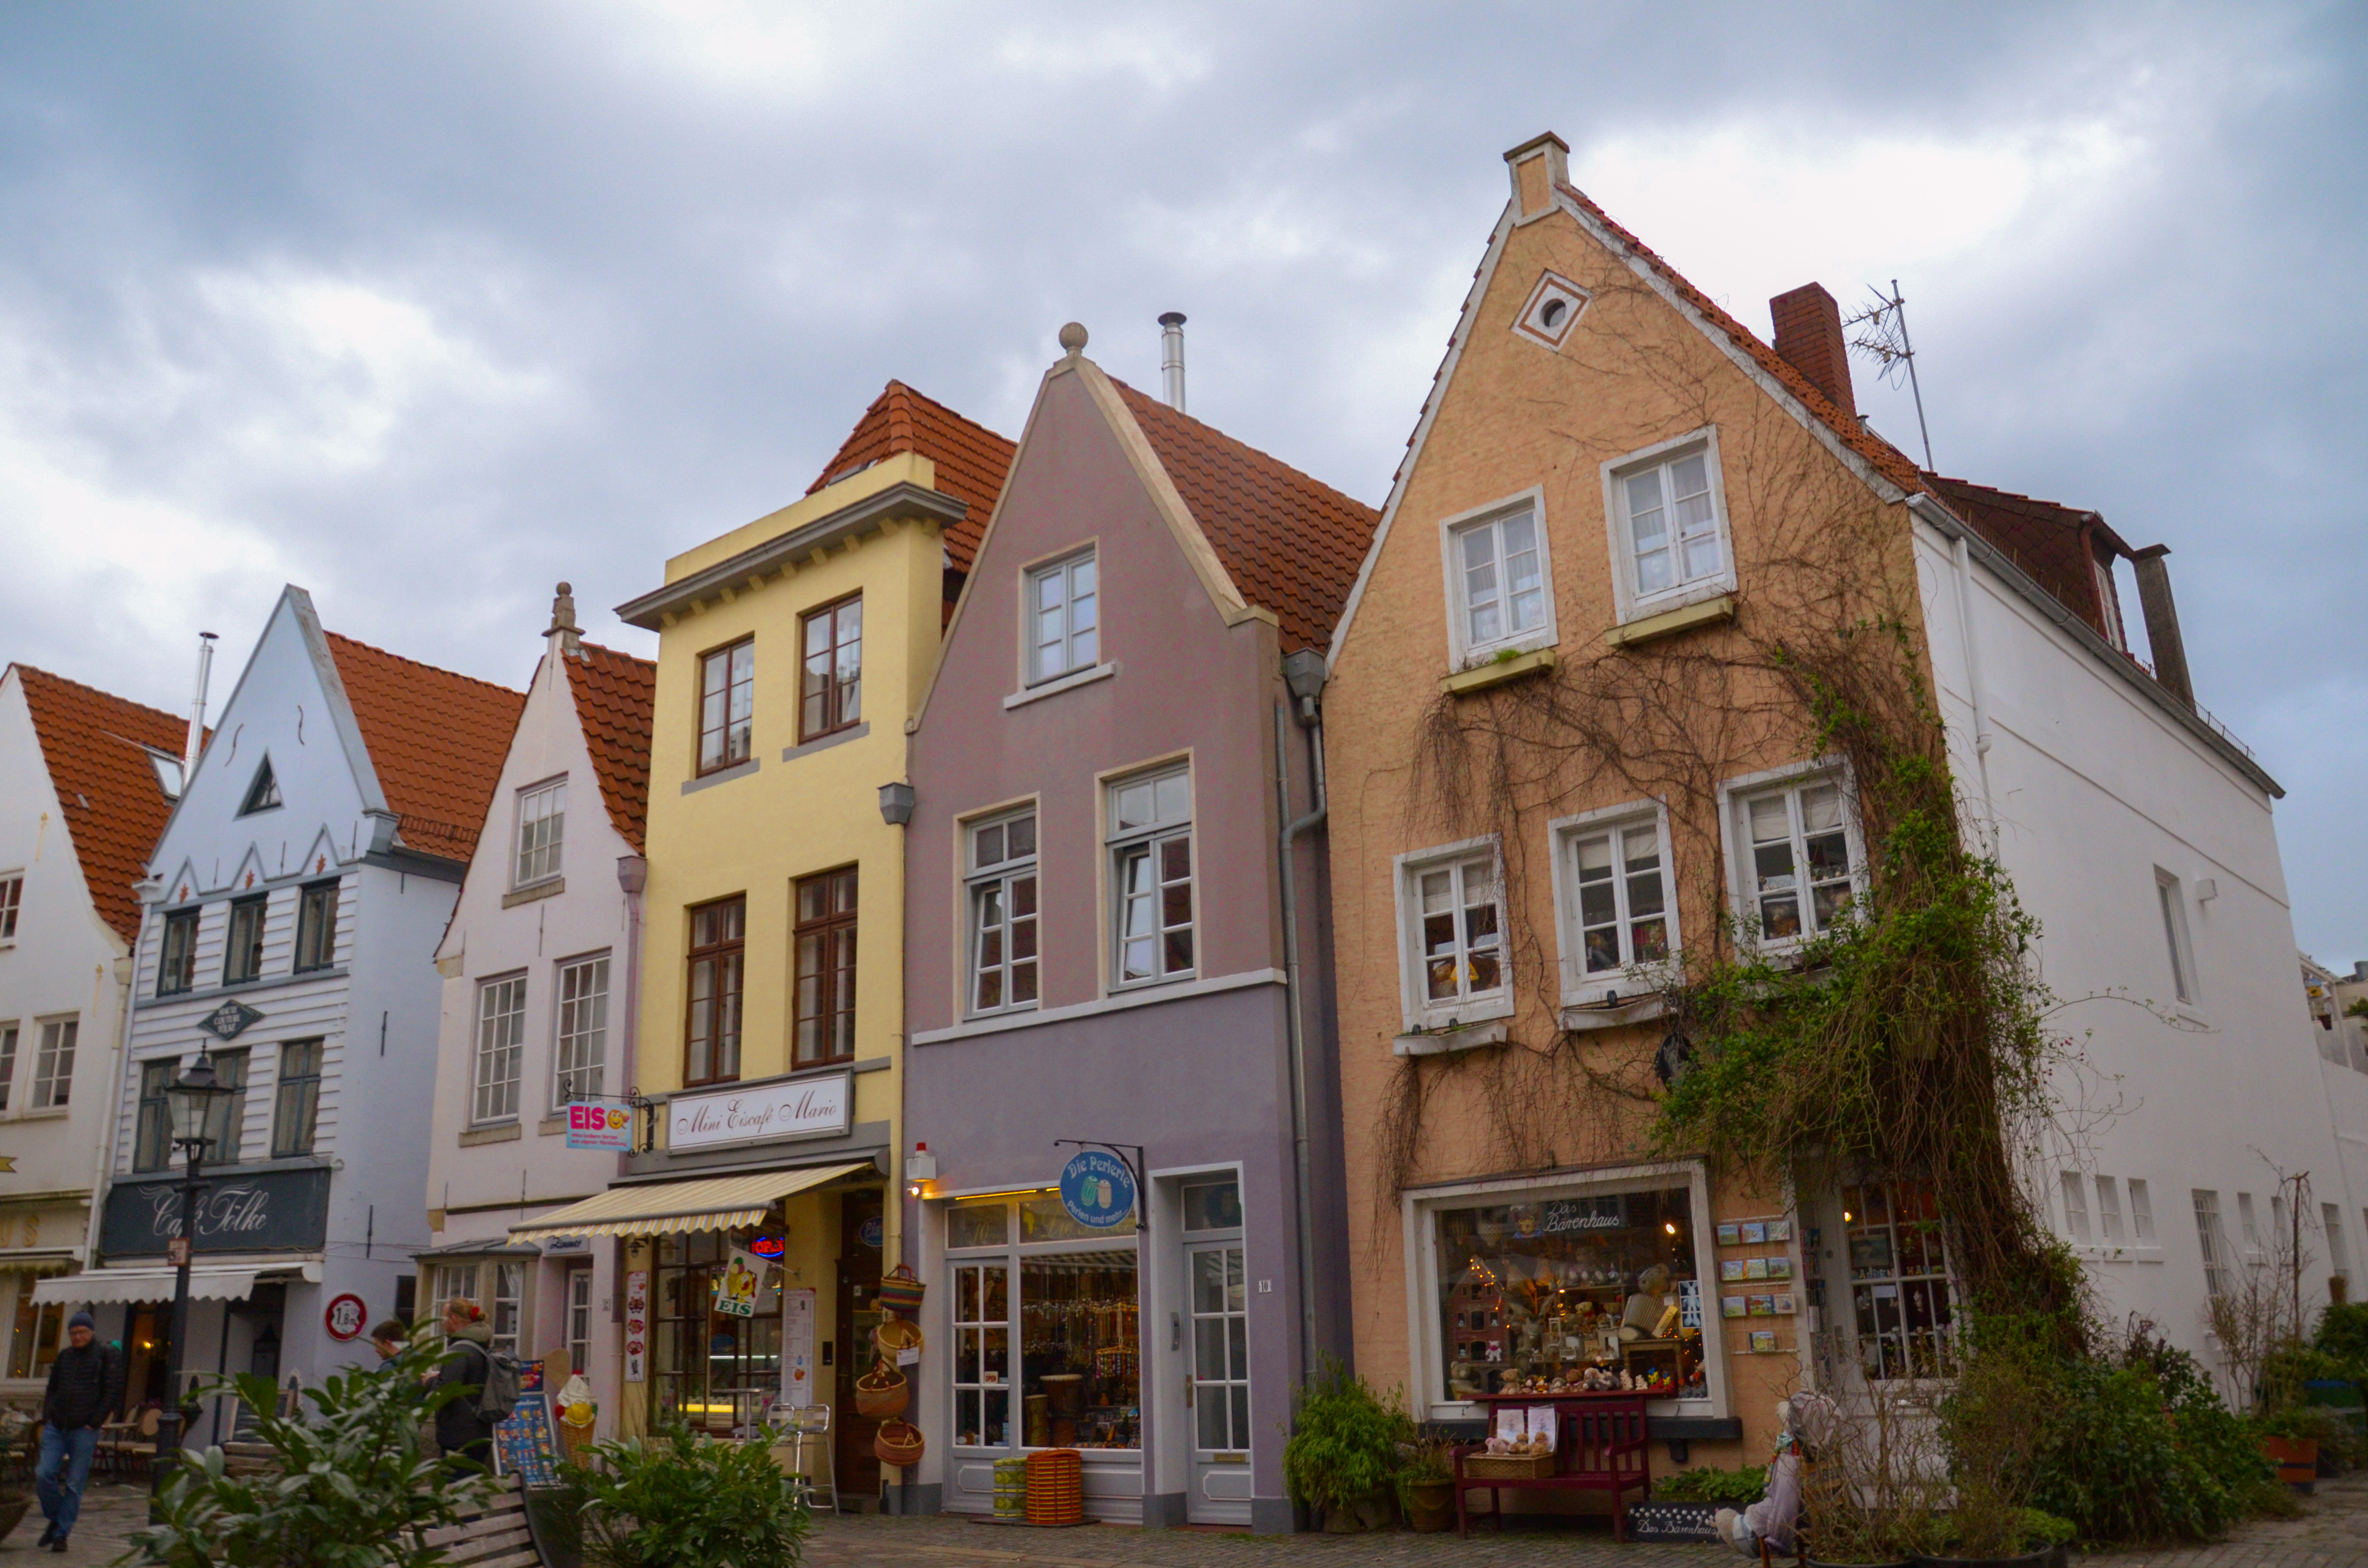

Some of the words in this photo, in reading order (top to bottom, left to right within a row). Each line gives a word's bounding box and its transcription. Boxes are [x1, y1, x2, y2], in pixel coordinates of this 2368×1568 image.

[570, 1106, 605, 1131] EIS
[677, 1104, 722, 1134] Mini
[727, 1099, 774, 1133] Eiscafé
[779, 1090, 837, 1121] Mario
[1068, 1161, 1087, 1179] Die
[1090, 1156, 1130, 1188] Perlerie
[1067, 1200, 1089, 1222] Perlen
[1090, 1215, 1105, 1224] und
[1548, 1202, 1577, 1215] Das
[1542, 1210, 1619, 1232] Bärenhaus
[1261, 1281, 1268, 1292] 10
[718, 1299, 752, 1315] EIS
[1637, 1519, 1658, 1532] Das
